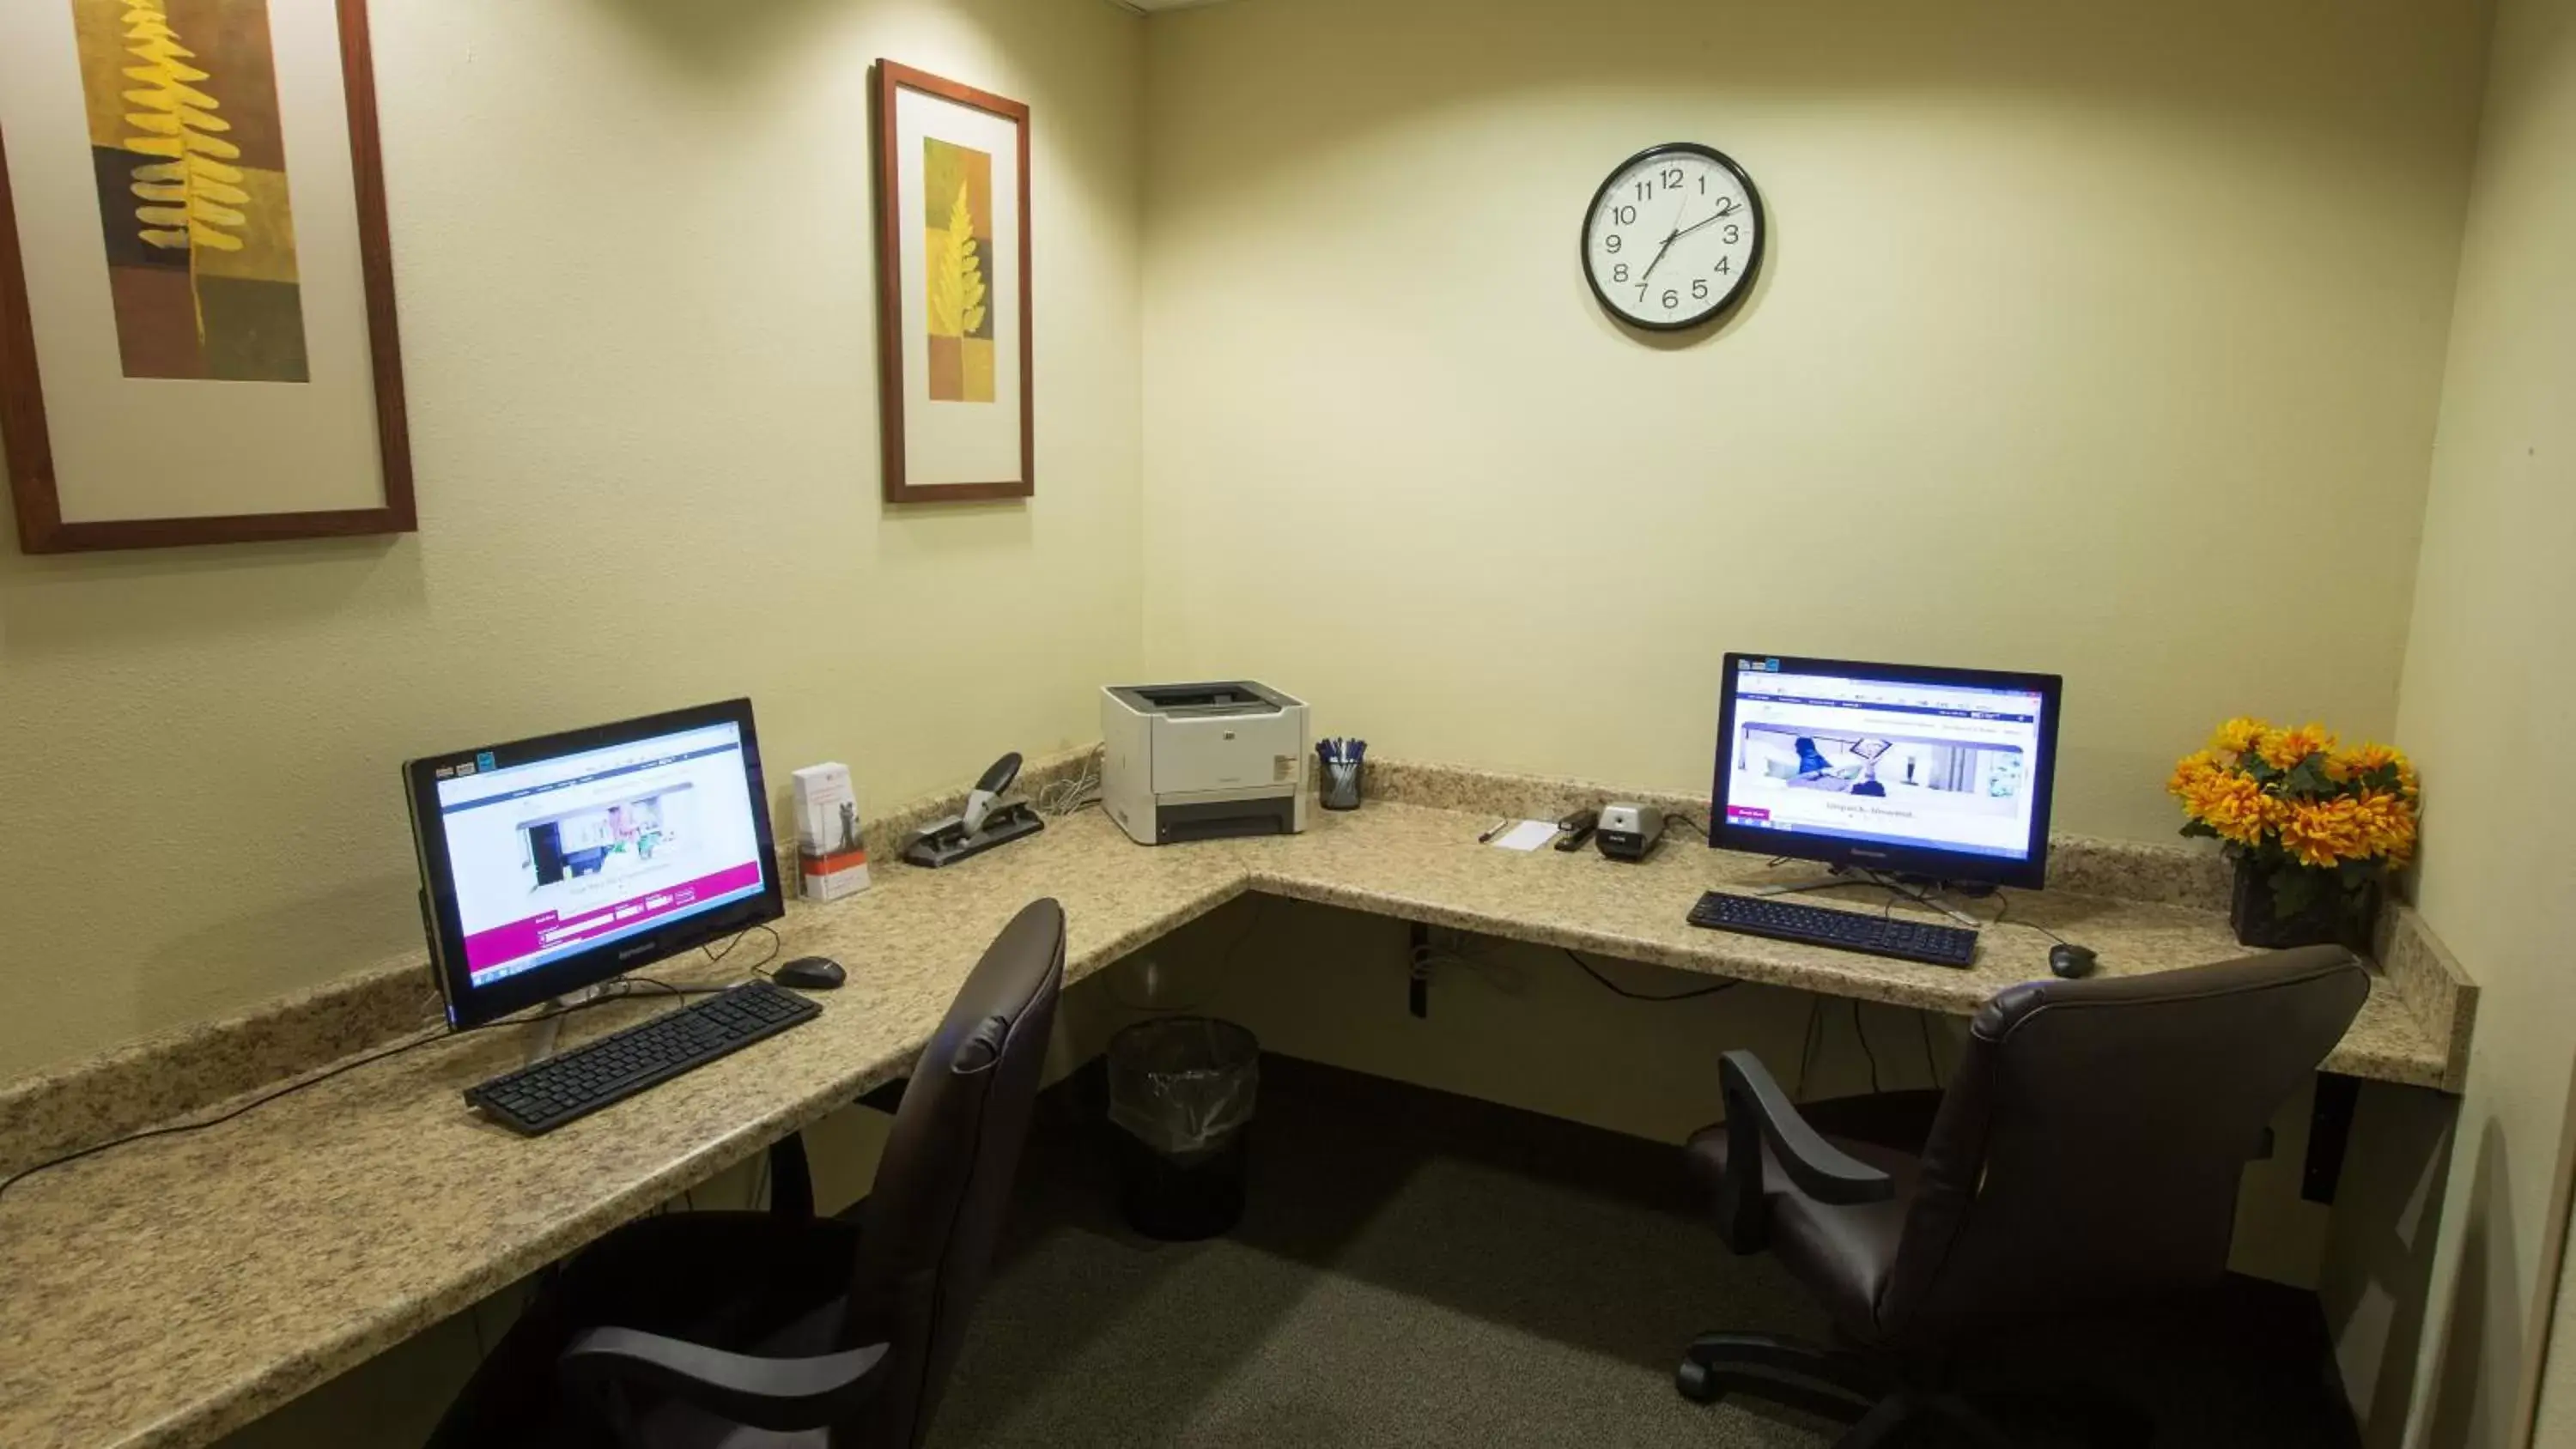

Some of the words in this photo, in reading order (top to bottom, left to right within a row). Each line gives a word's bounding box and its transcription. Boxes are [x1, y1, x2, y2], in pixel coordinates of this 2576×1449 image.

[1661, 169, 1683, 189] 12
[1698, 175, 1704, 195] 1
[1635, 180, 1651, 201] 11
[1613, 206, 1636, 225] 10
[1716, 197, 1732, 215] 2
[1722, 225, 1738, 244] 3
[1606, 235, 1621, 254] 9
[1613, 264, 1628, 282] 8
[1714, 256, 1729, 275] 4
[1635, 283, 1649, 302] 7
[1692, 279, 1708, 299] 5
[1662, 290, 1678, 309] 6
